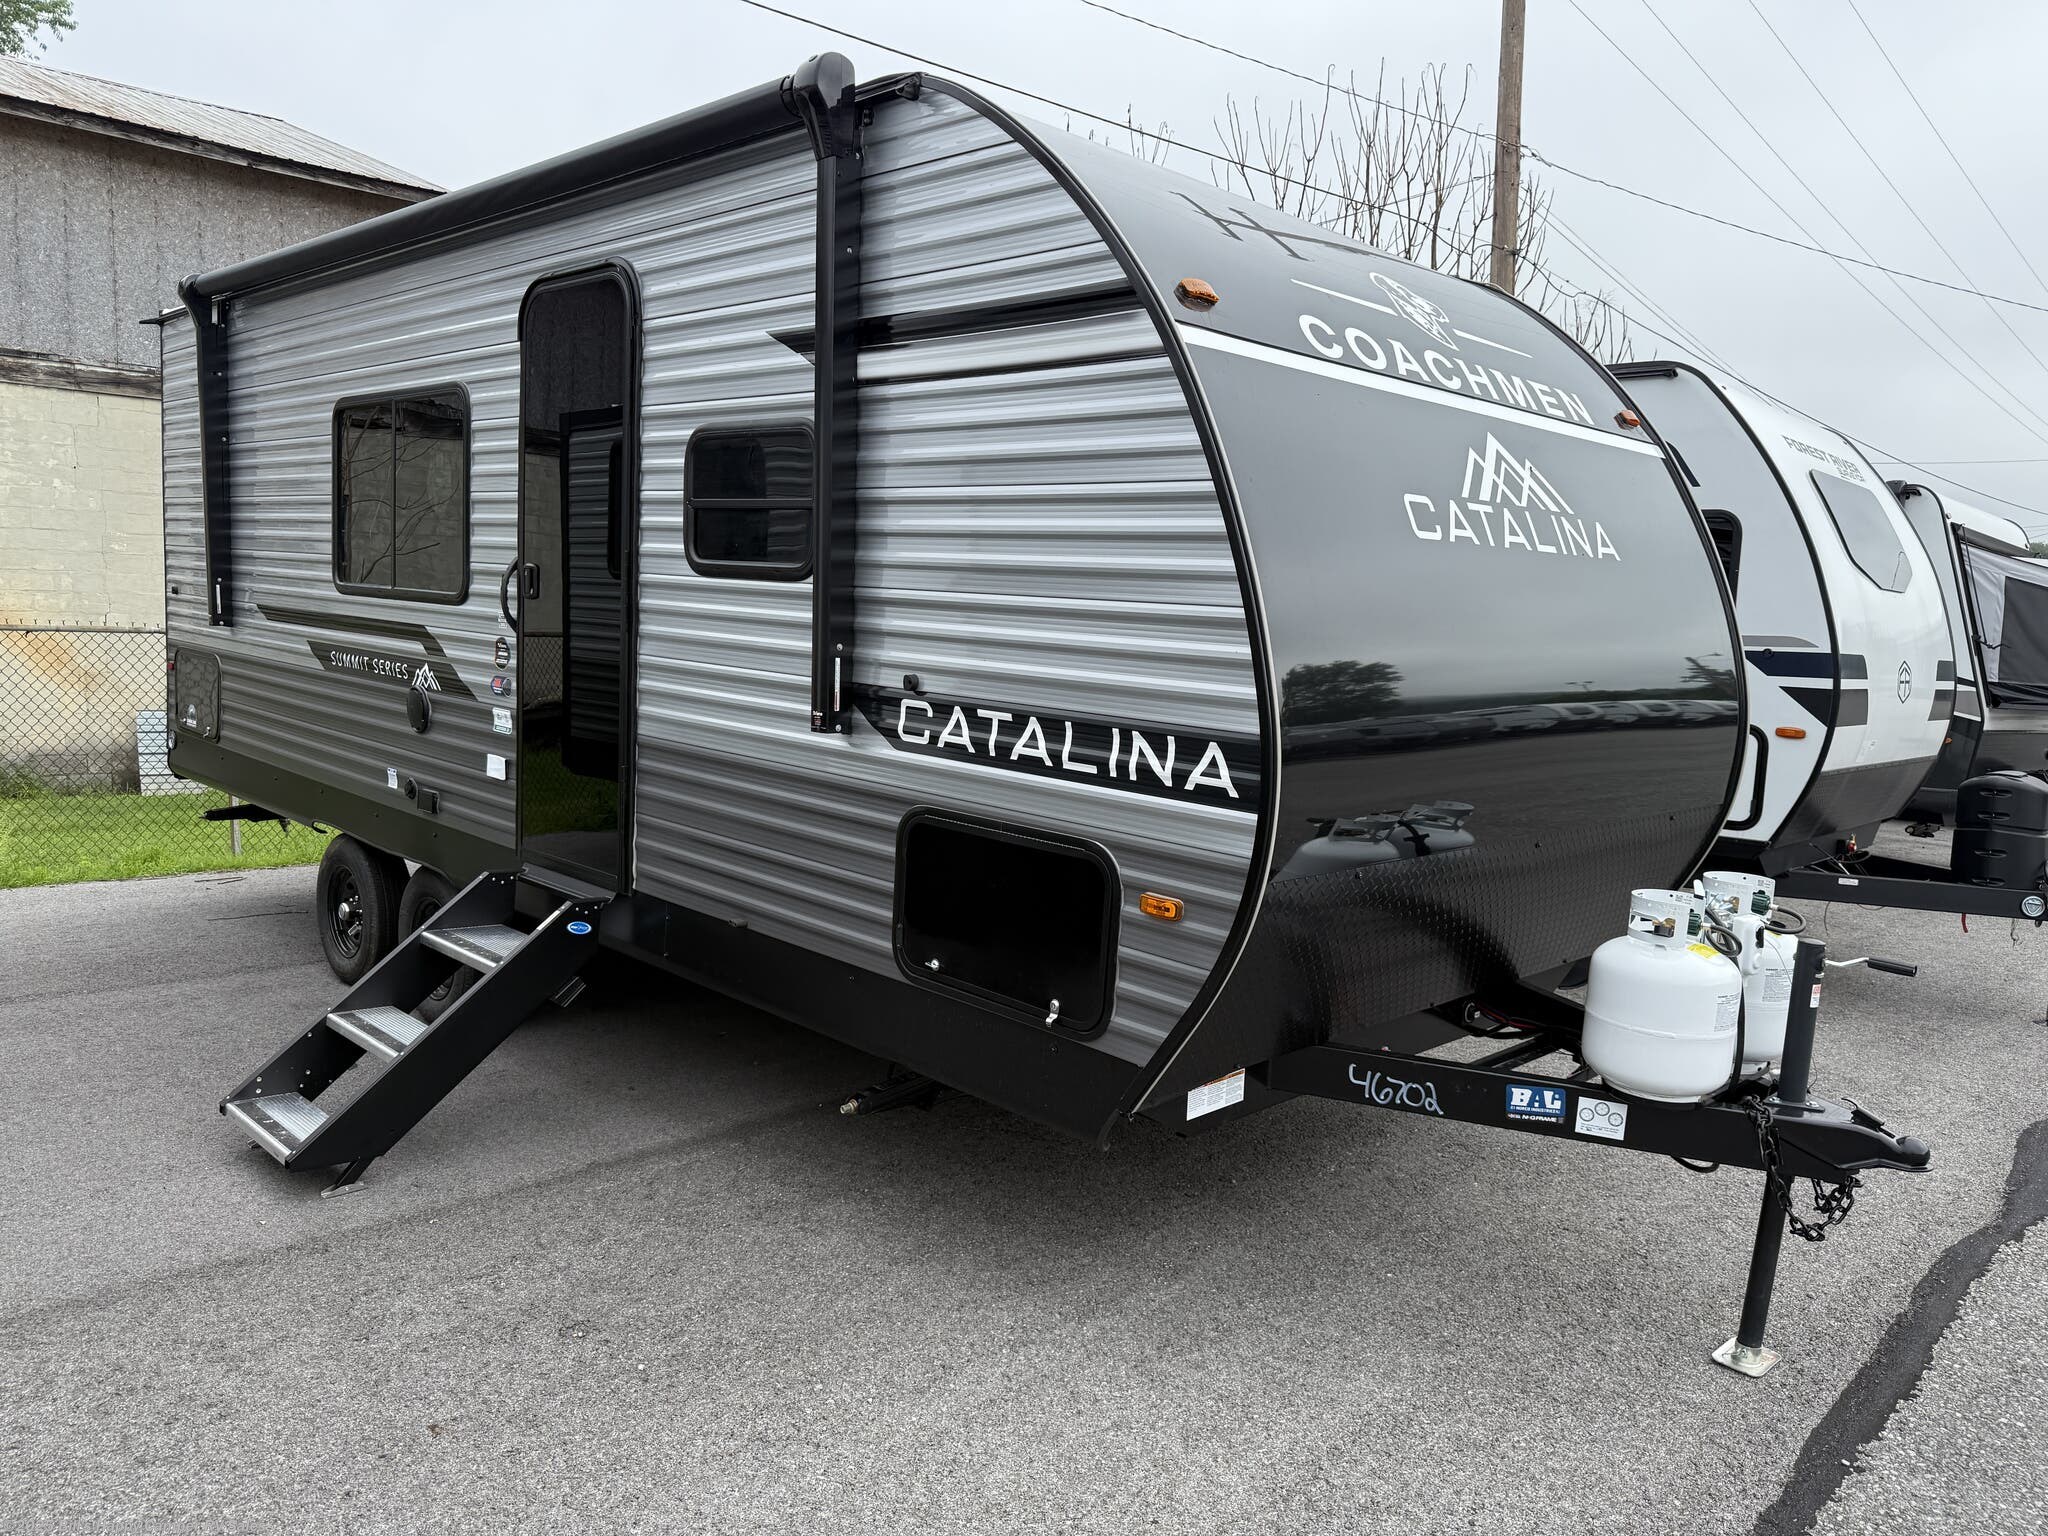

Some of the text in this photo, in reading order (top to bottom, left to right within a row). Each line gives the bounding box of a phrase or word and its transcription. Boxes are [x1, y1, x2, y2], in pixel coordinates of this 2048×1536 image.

[1298, 314, 1595, 425] COACHMEN
[1782, 435, 1830, 464] FOREST
[1403, 493, 1622, 561] CATALINA
[330, 650, 409, 679] SUMMIT SERIES
[897, 698, 1240, 799] CATALINA
[1348, 1063, 1444, 1115] 46702
[1510, 1087, 1562, 1109] BAL
